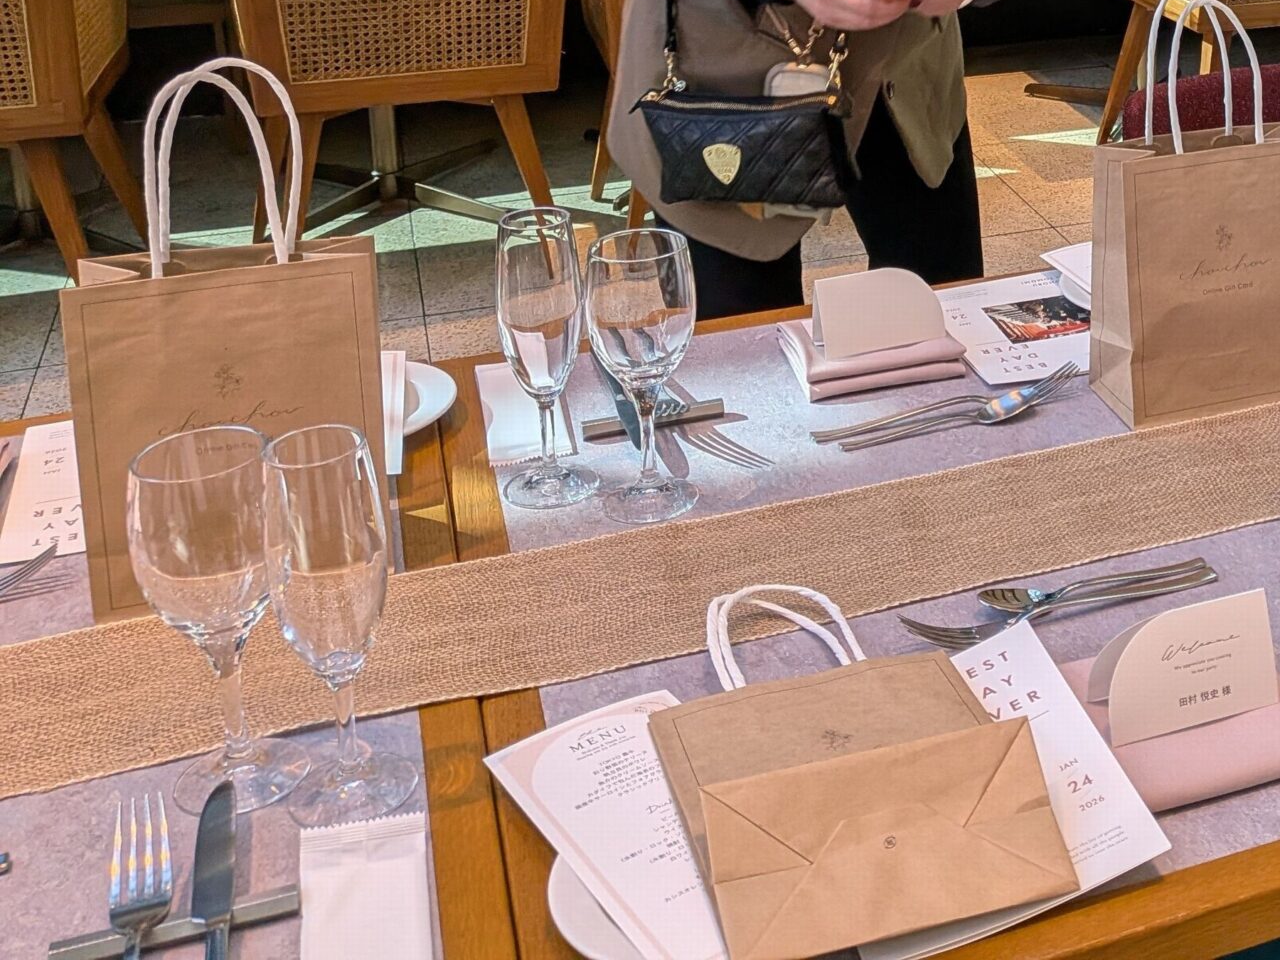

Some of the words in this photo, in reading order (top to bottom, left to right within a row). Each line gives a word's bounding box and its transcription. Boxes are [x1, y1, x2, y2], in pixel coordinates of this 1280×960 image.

[981, 344, 1030, 355] EVER
[1000, 353, 1039, 363] DAY
[1003, 362, 1048, 374] BEST
[44, 456, 65, 466] 24
[33, 503, 82, 518] VER
[43, 518, 79, 531] AY
[32, 532, 79, 547] EST
[1161, 634, 1240, 662] Welcome
[965, 650, 1010, 680] EST
[981, 675, 1014, 700] AY
[988, 690, 1042, 720] VER
[1178, 693, 1198, 708] 田村
[569, 725, 626, 753] MENU
[1059, 758, 1079, 772] JAN
[1066, 774, 1094, 794] 24
[1079, 795, 1105, 812] 2026
